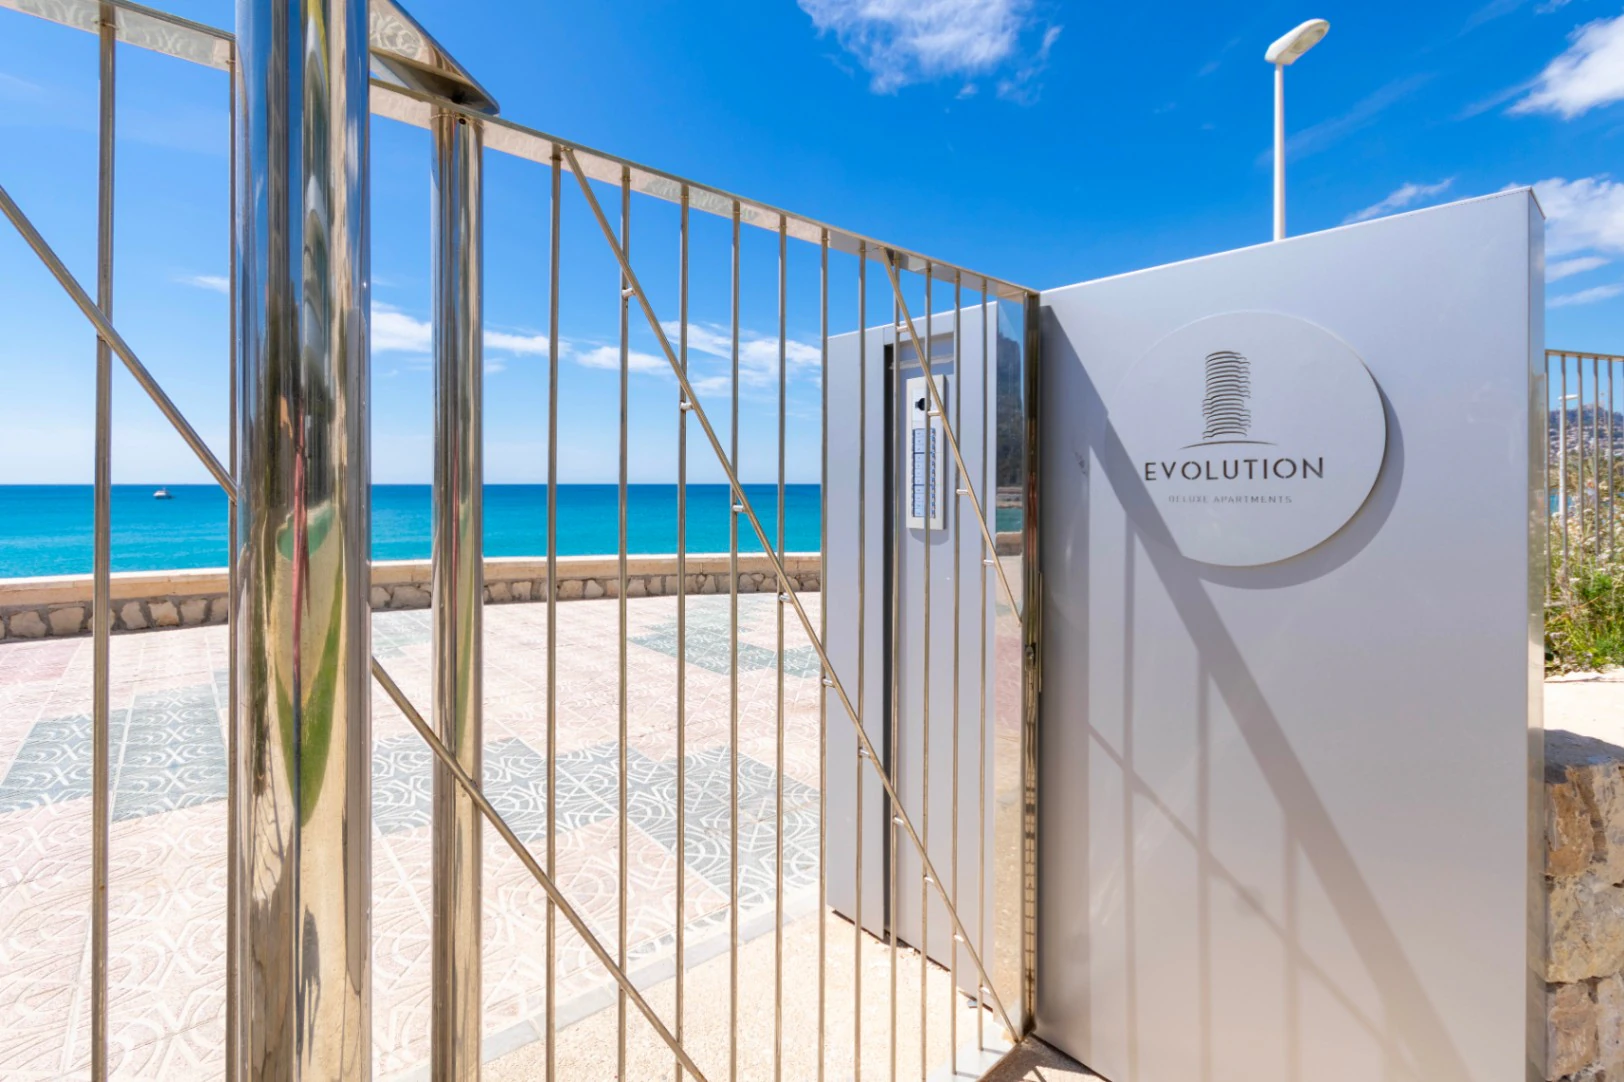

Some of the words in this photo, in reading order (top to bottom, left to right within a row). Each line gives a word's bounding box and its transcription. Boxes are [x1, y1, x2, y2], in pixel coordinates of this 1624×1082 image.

[1144, 456, 1324, 482] EVOLUTION
[1167, 495, 1209, 504] DELUXE
[1213, 495, 1293, 504] APARTMENTS
